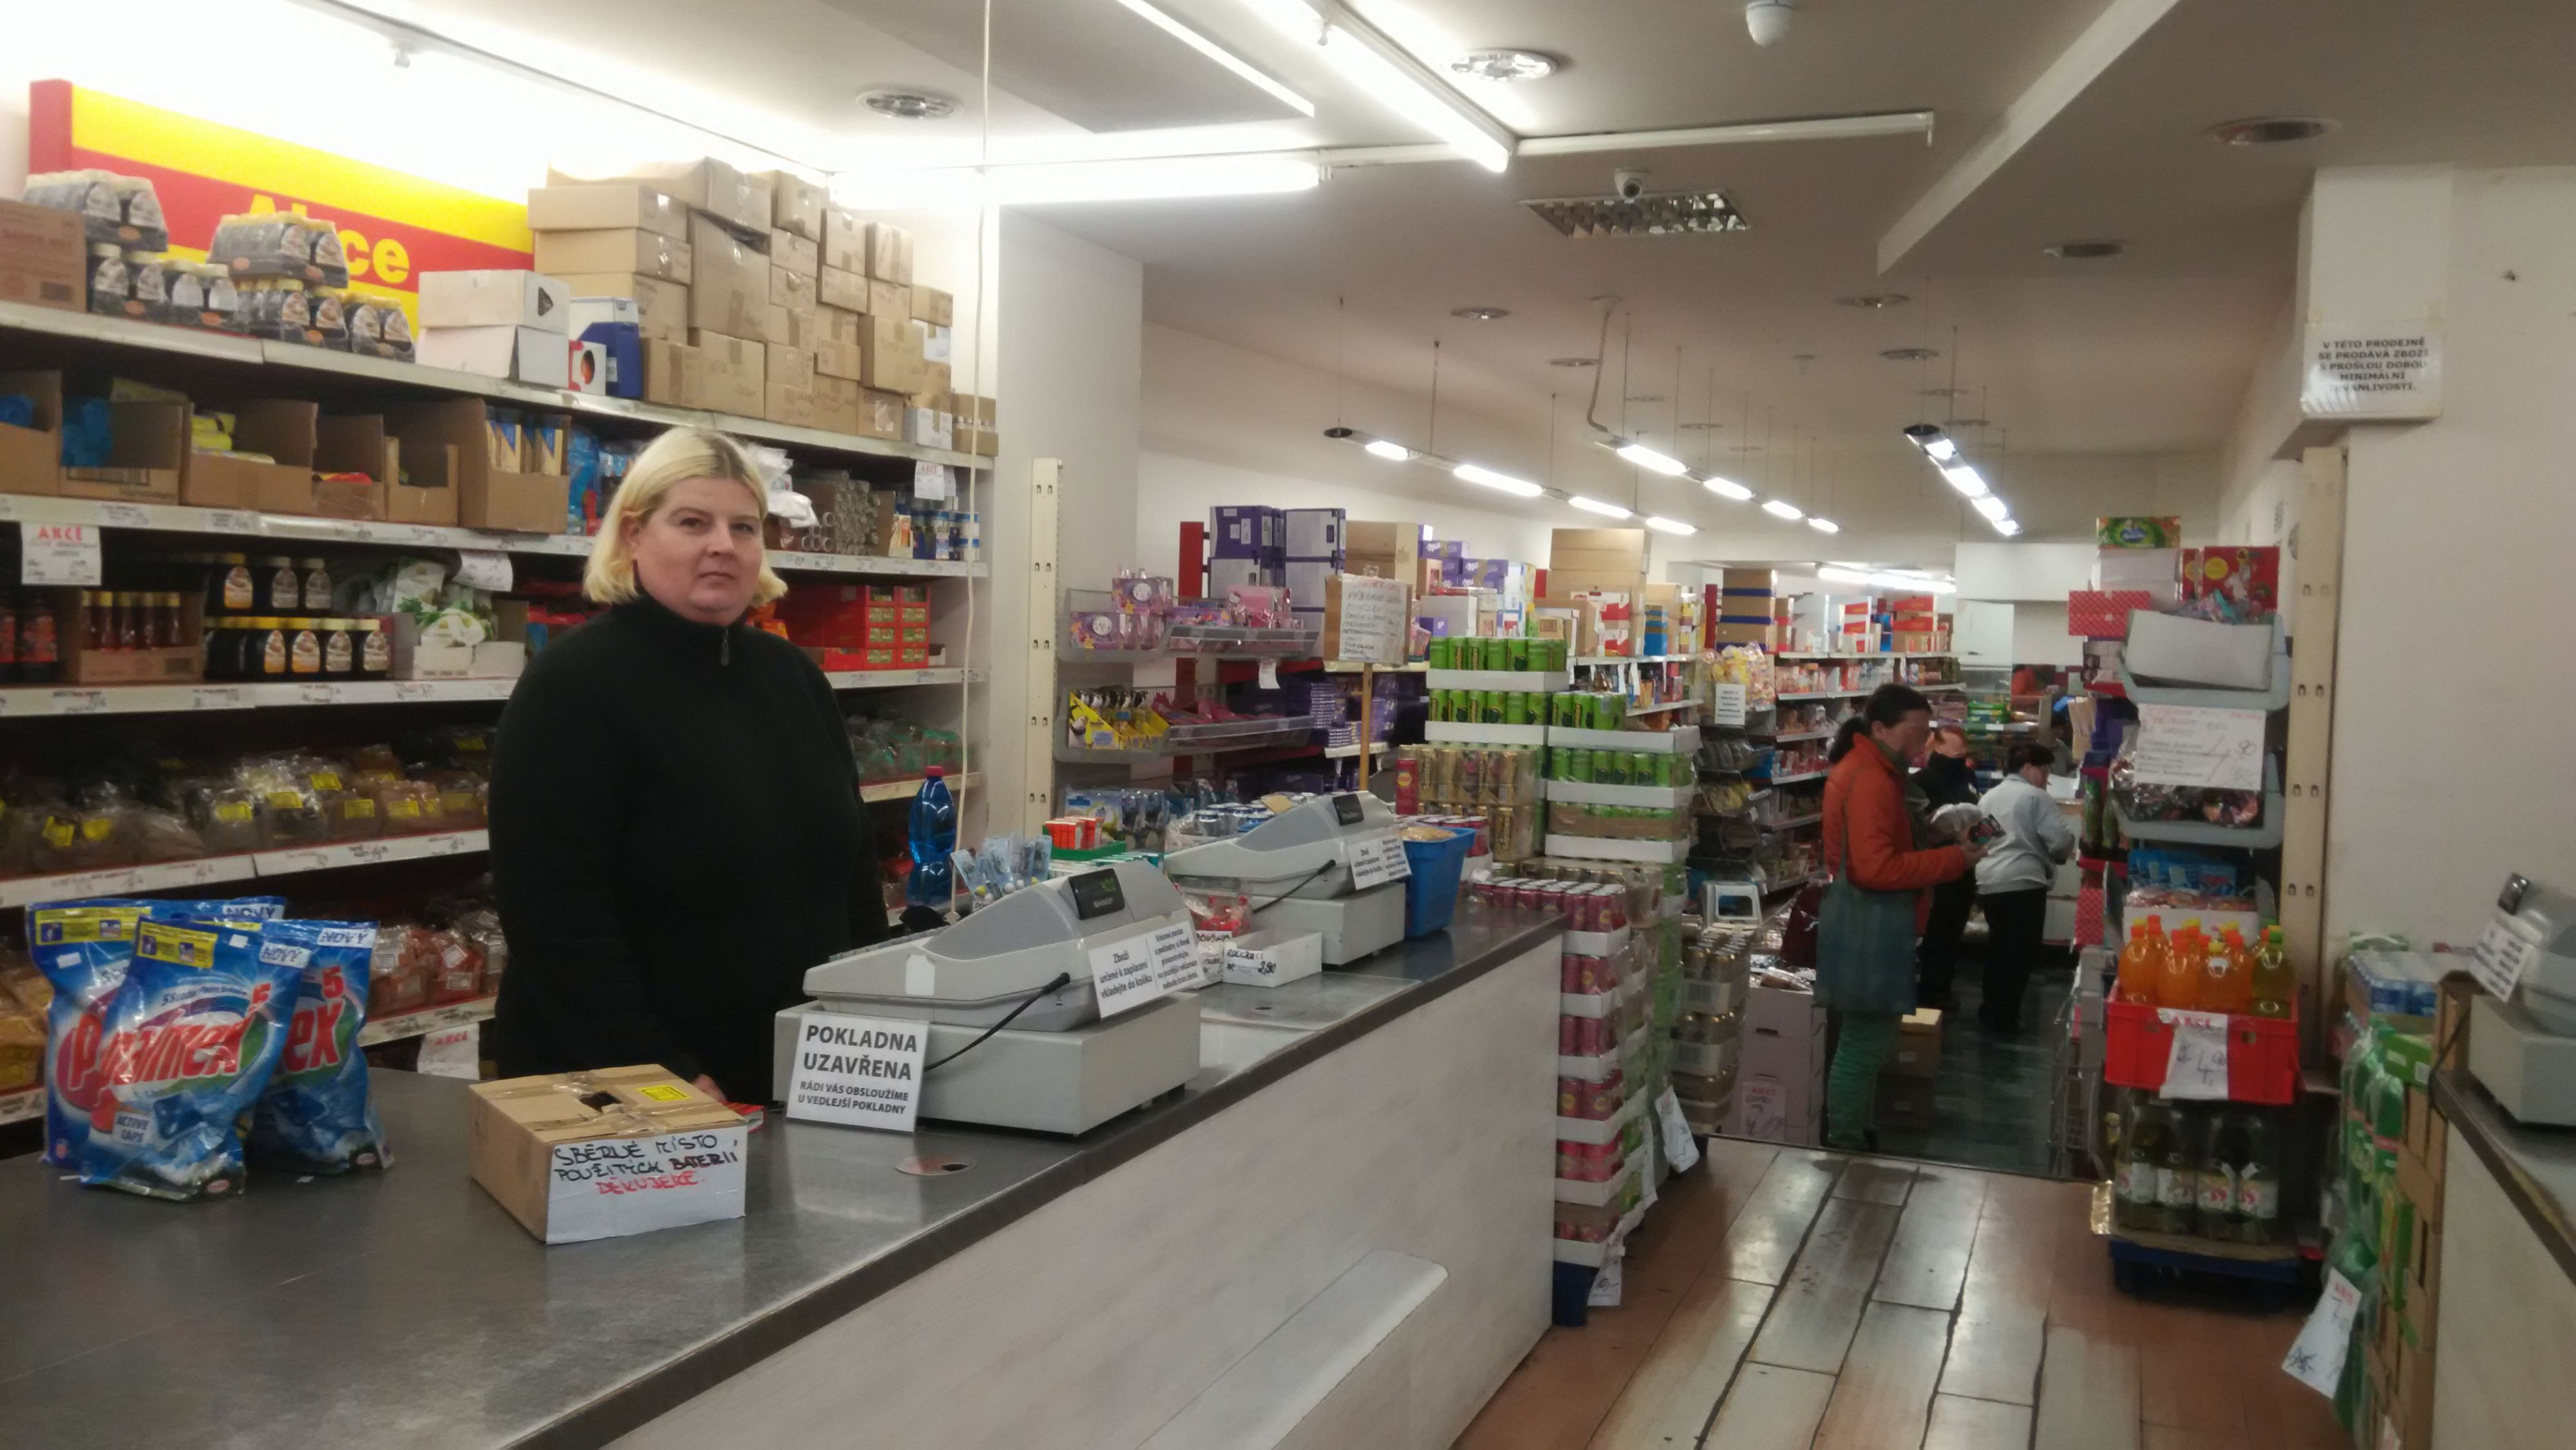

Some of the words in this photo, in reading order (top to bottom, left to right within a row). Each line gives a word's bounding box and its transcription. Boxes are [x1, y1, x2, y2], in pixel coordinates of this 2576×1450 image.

[250, 193, 410, 283] ce
[2334, 339, 2362, 348] TÉTO
[2366, 336, 2425, 347] PRODEJNĚ
[2335, 349, 2389, 359] PRODÁVÁ
[2330, 360, 2382, 370] PROŠLOU
[2340, 370, 2405, 381] MINIMÁLNÍ
[806, 1024, 917, 1053] POKLADNA
[804, 1053, 911, 1081] UZAVŘENA
[800, 1080, 824, 1092] RÁDI
[826, 1083, 844, 1094] VÁS
[846, 1086, 909, 1102] OBSLOUŽÍME
[798, 1094, 805, 1103] U
[807, 1095, 851, 1109] VEDLEJŠÍ
[853, 1100, 905, 1114] POKLADNY
